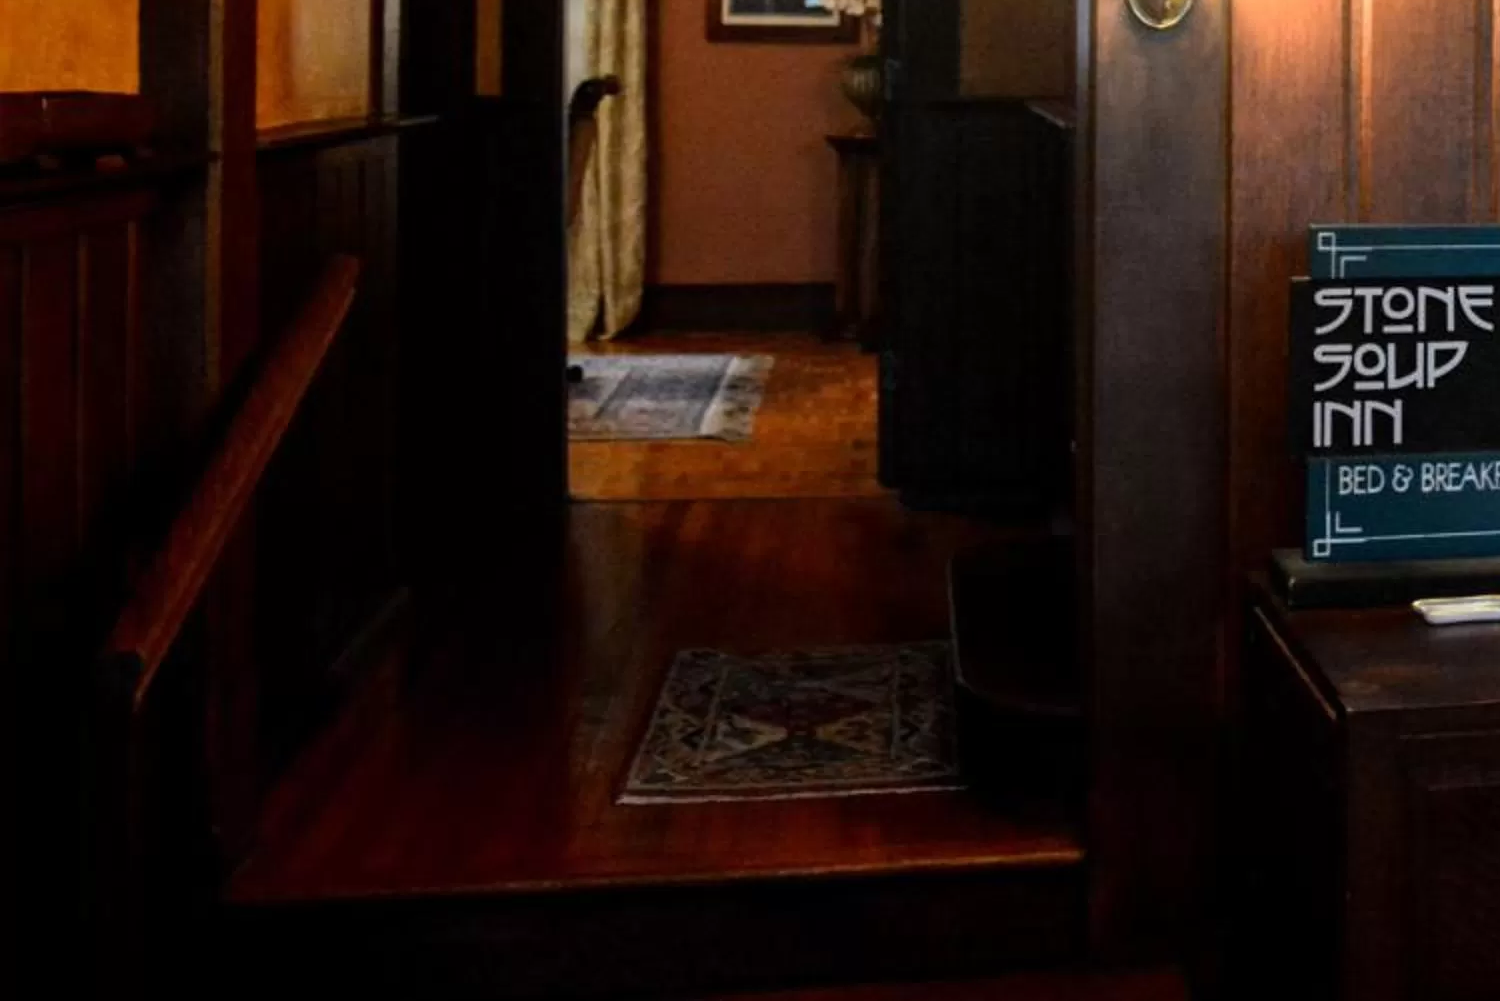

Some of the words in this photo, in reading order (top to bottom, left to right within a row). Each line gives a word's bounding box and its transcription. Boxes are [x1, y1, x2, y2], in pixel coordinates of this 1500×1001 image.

[1313, 285, 1495, 335] STONE
[1313, 340, 1470, 391] SOUP
[1313, 399, 1403, 448] INN
[1338, 465, 1385, 495] BED
[1391, 463, 1414, 492] &
